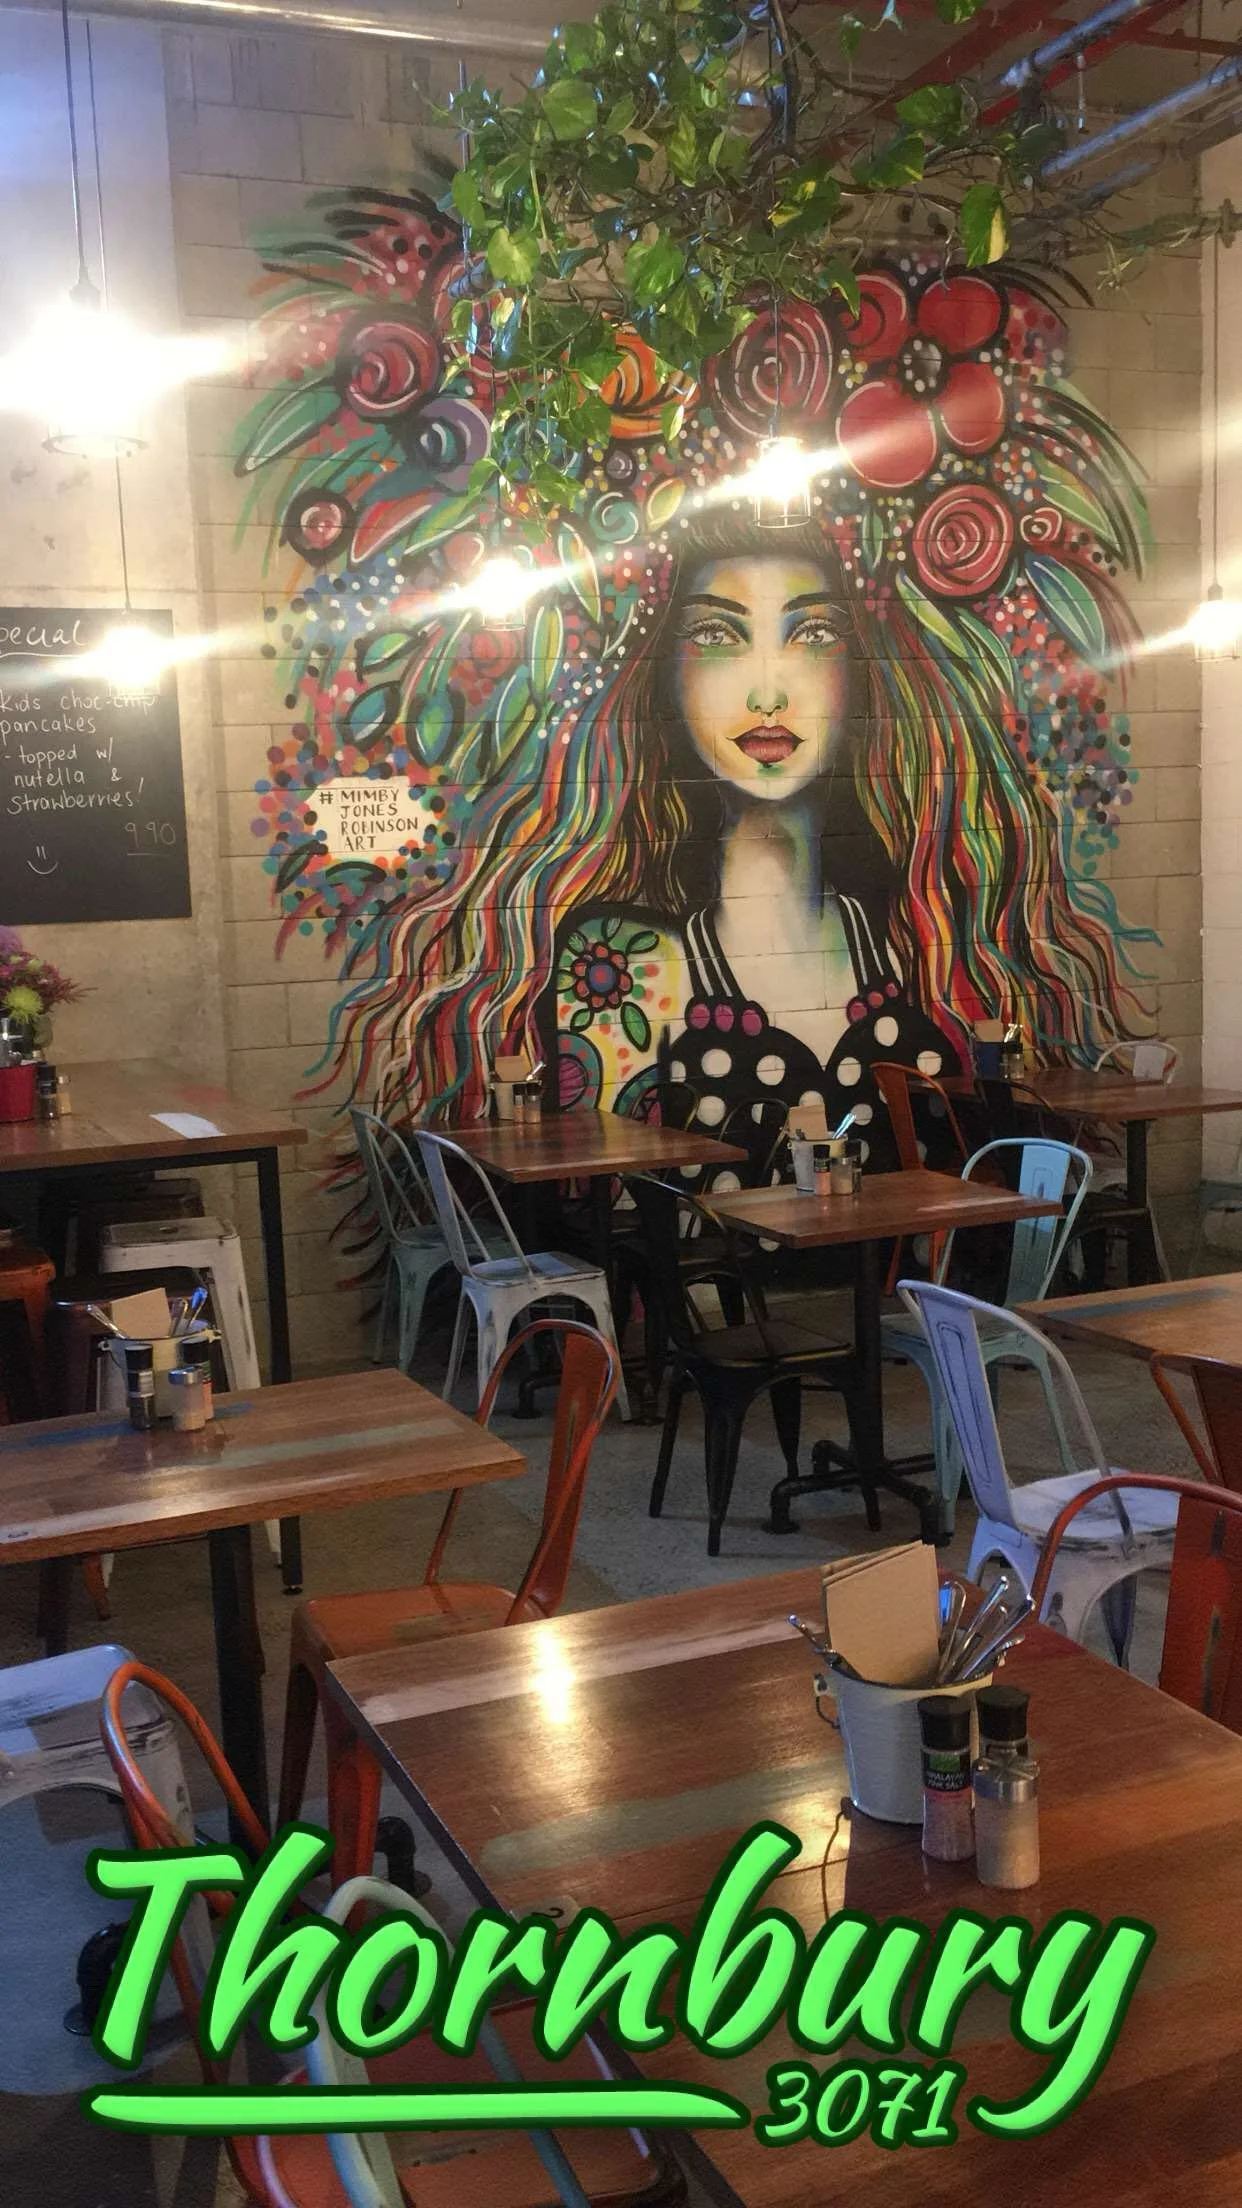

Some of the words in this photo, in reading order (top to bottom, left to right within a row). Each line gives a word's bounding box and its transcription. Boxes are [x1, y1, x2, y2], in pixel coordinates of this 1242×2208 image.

[0, 713, 97, 746] pancakes
[19, 744, 77, 769] topped
[14, 768, 85, 788] nutella
[111, 768, 122, 782] &
[340, 803, 398, 819] JONES
[341, 817, 418, 836] ROBINSON
[344, 836, 377, 851] ART
